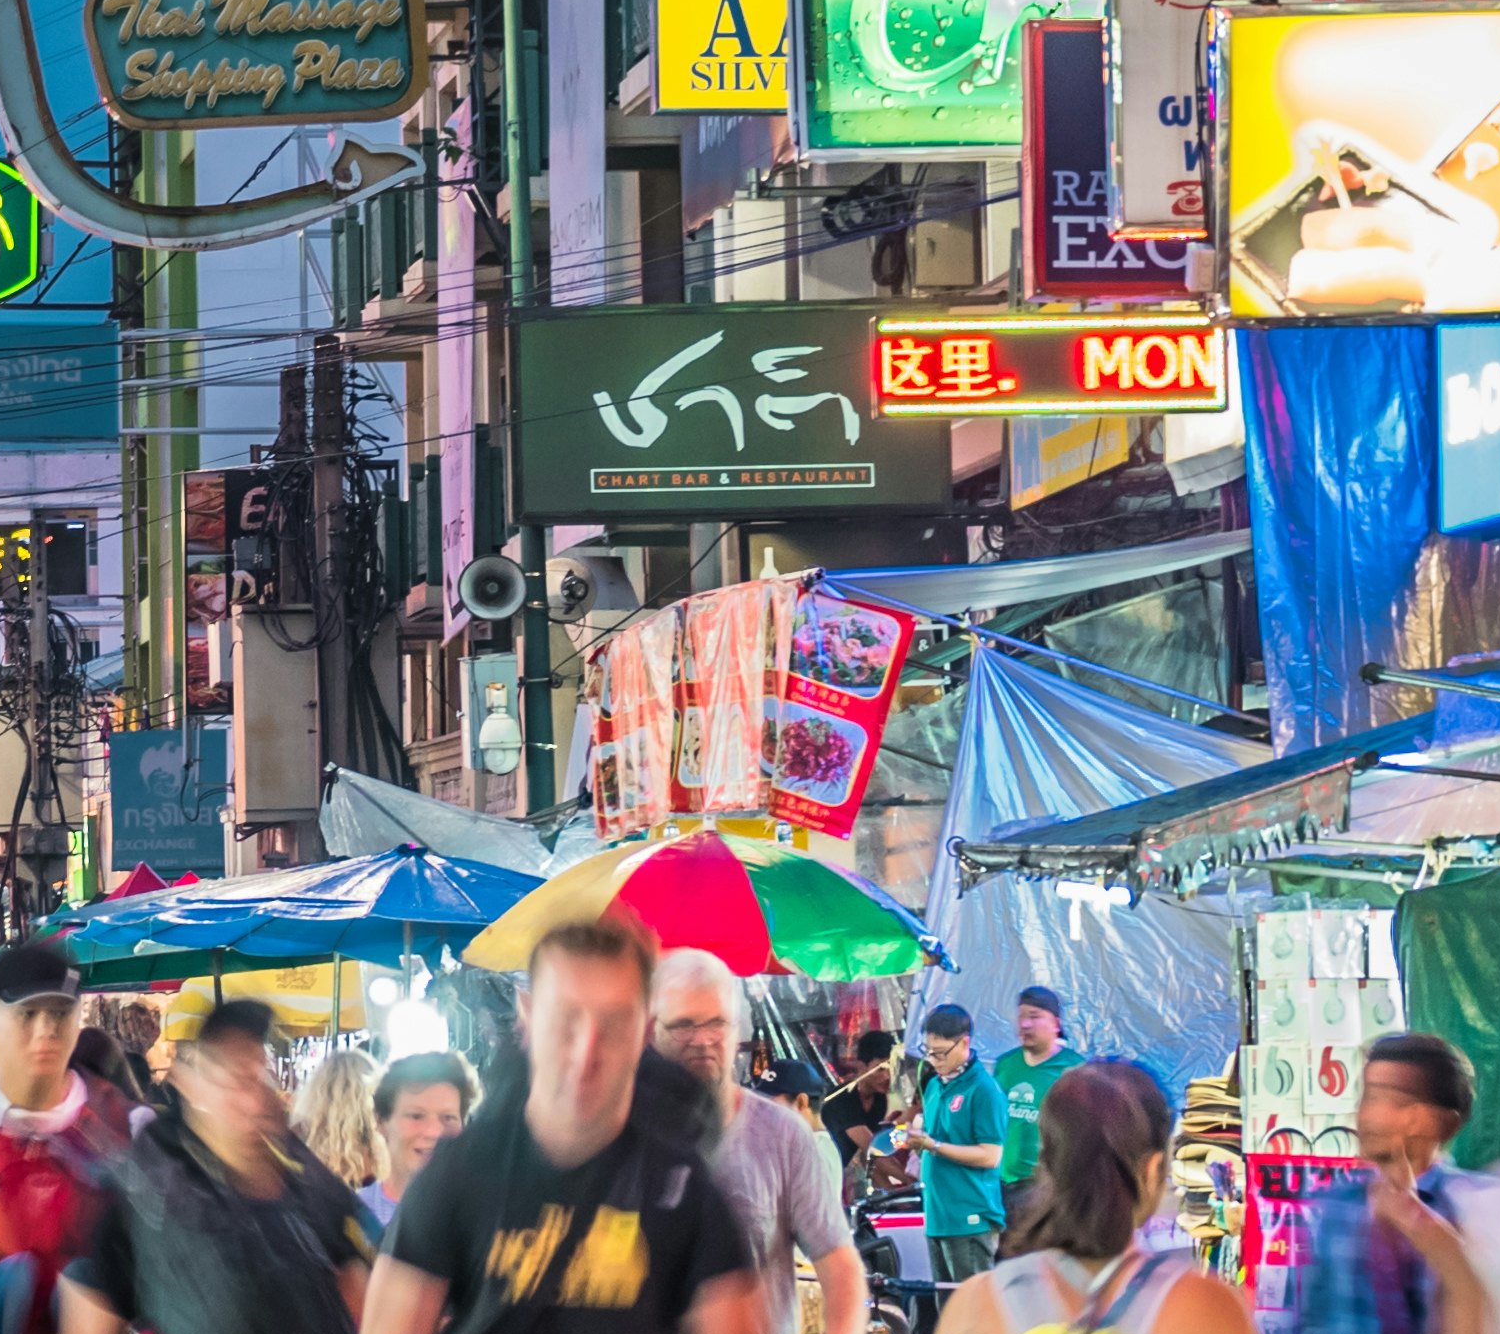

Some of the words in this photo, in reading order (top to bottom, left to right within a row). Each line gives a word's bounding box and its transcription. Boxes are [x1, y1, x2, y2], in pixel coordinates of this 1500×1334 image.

[122, 48, 286, 111] Shopping
[293, 40, 405, 93] Plaza
[596, 473, 664, 488] CHART
[671, 472, 711, 486] BAR
[718, 471, 732, 486] &
[740, 468, 872, 485] RESTAURANT
